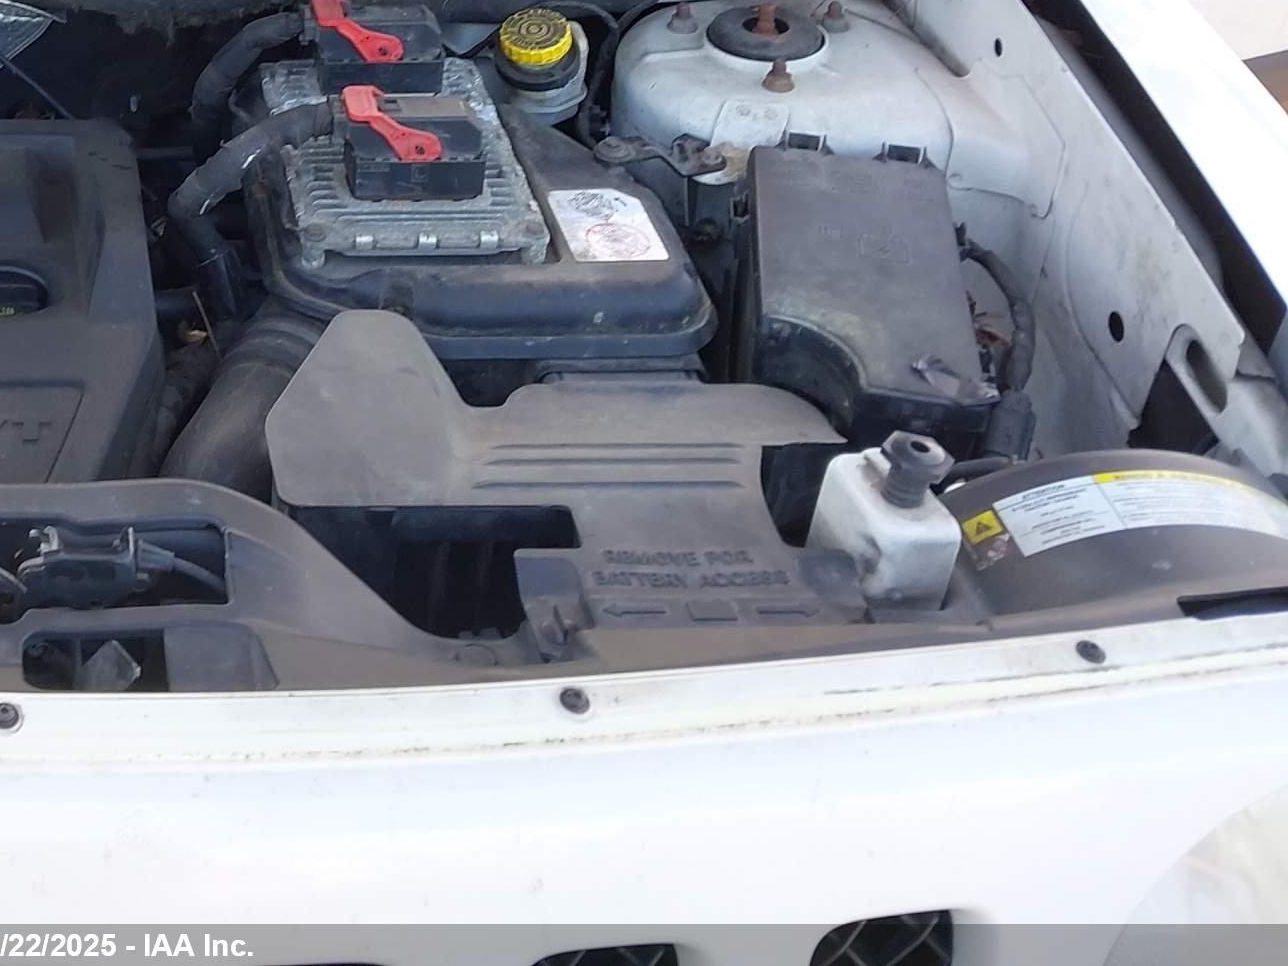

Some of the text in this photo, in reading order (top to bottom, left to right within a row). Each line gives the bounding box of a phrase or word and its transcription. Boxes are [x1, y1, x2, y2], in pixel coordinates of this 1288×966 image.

[601, 549, 755, 567] REMOVE FOR
[590, 569, 792, 588] BATTERY ACCESS
